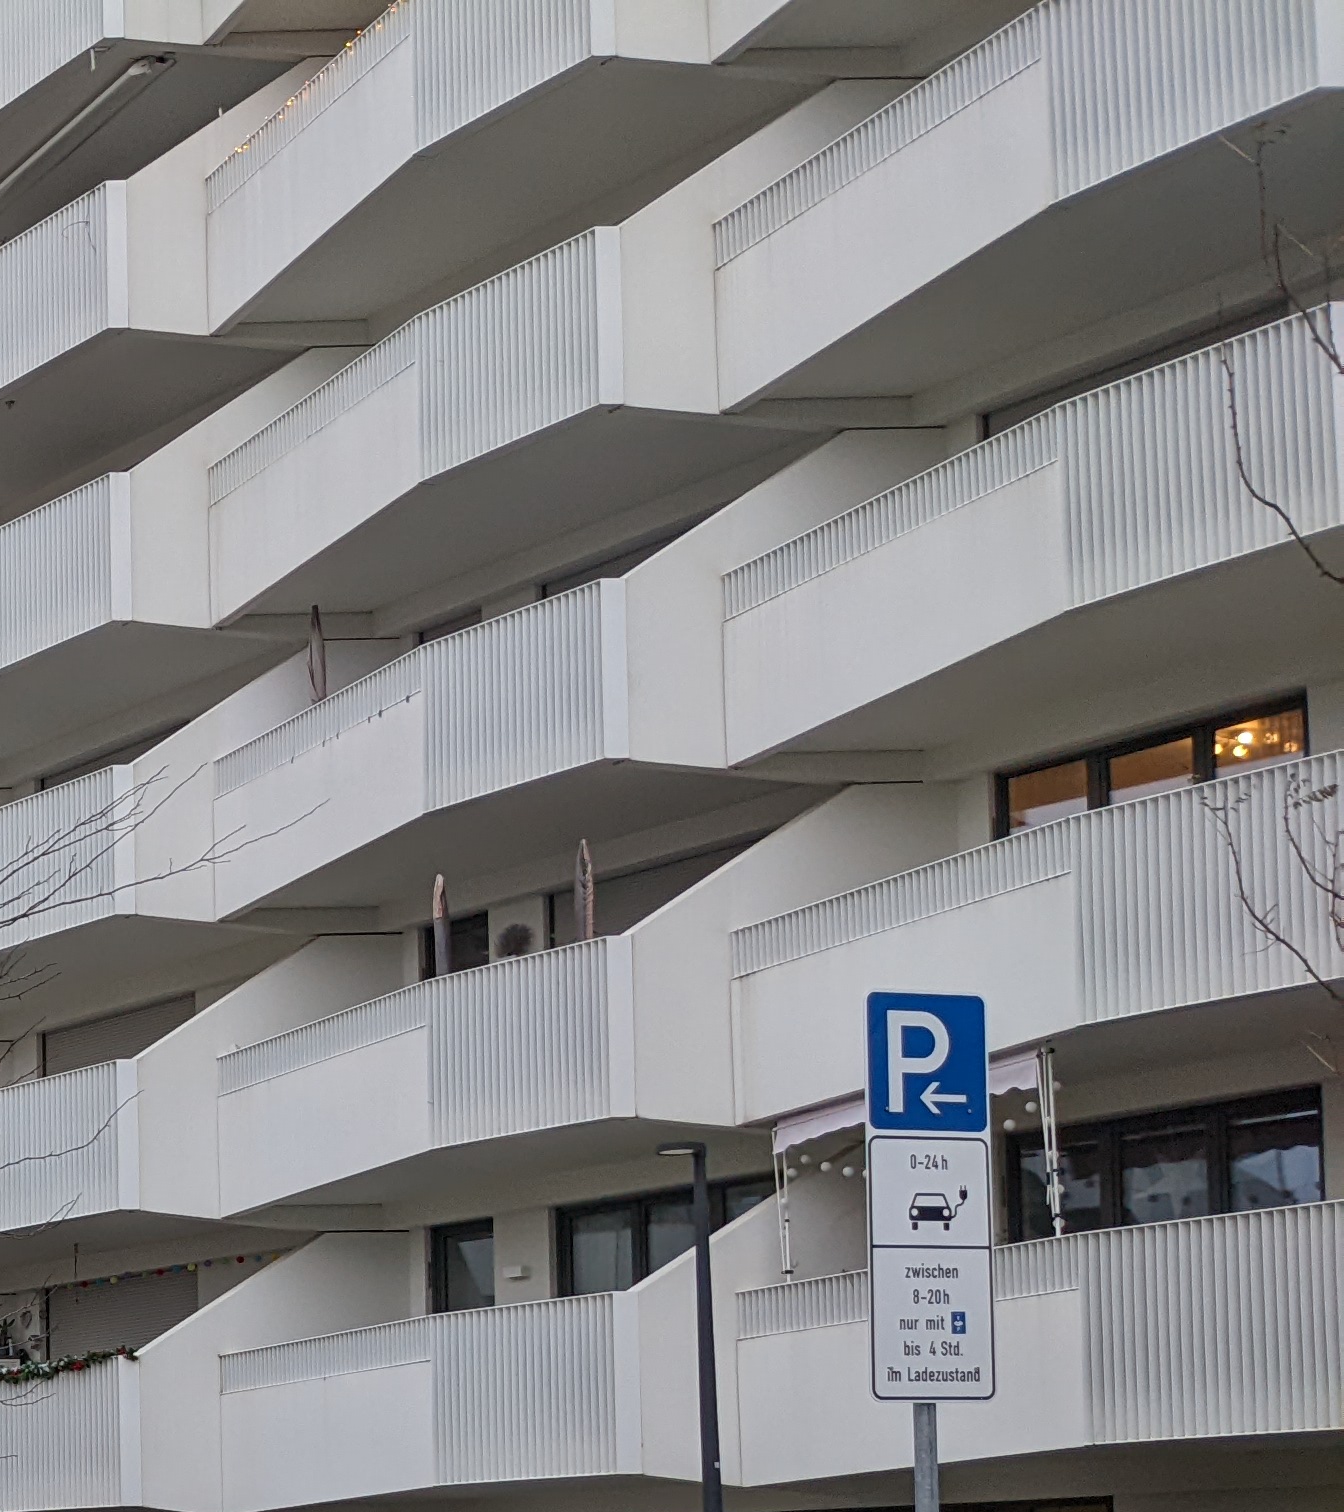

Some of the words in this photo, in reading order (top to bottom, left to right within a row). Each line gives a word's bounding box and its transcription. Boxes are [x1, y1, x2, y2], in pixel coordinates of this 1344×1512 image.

[887, 1010, 950, 1113] P
[905, 1263, 959, 1279] zwischen
[899, 1318, 920, 1330] nur
[925, 1315, 945, 1330] mit
[903, 1341, 921, 1356] bis
[929, 1341, 936, 1356] 4
[941, 1341, 964, 1357] Std.
[887, 1367, 902, 1382] im
[907, 1367, 981, 1382] Ladezustand
